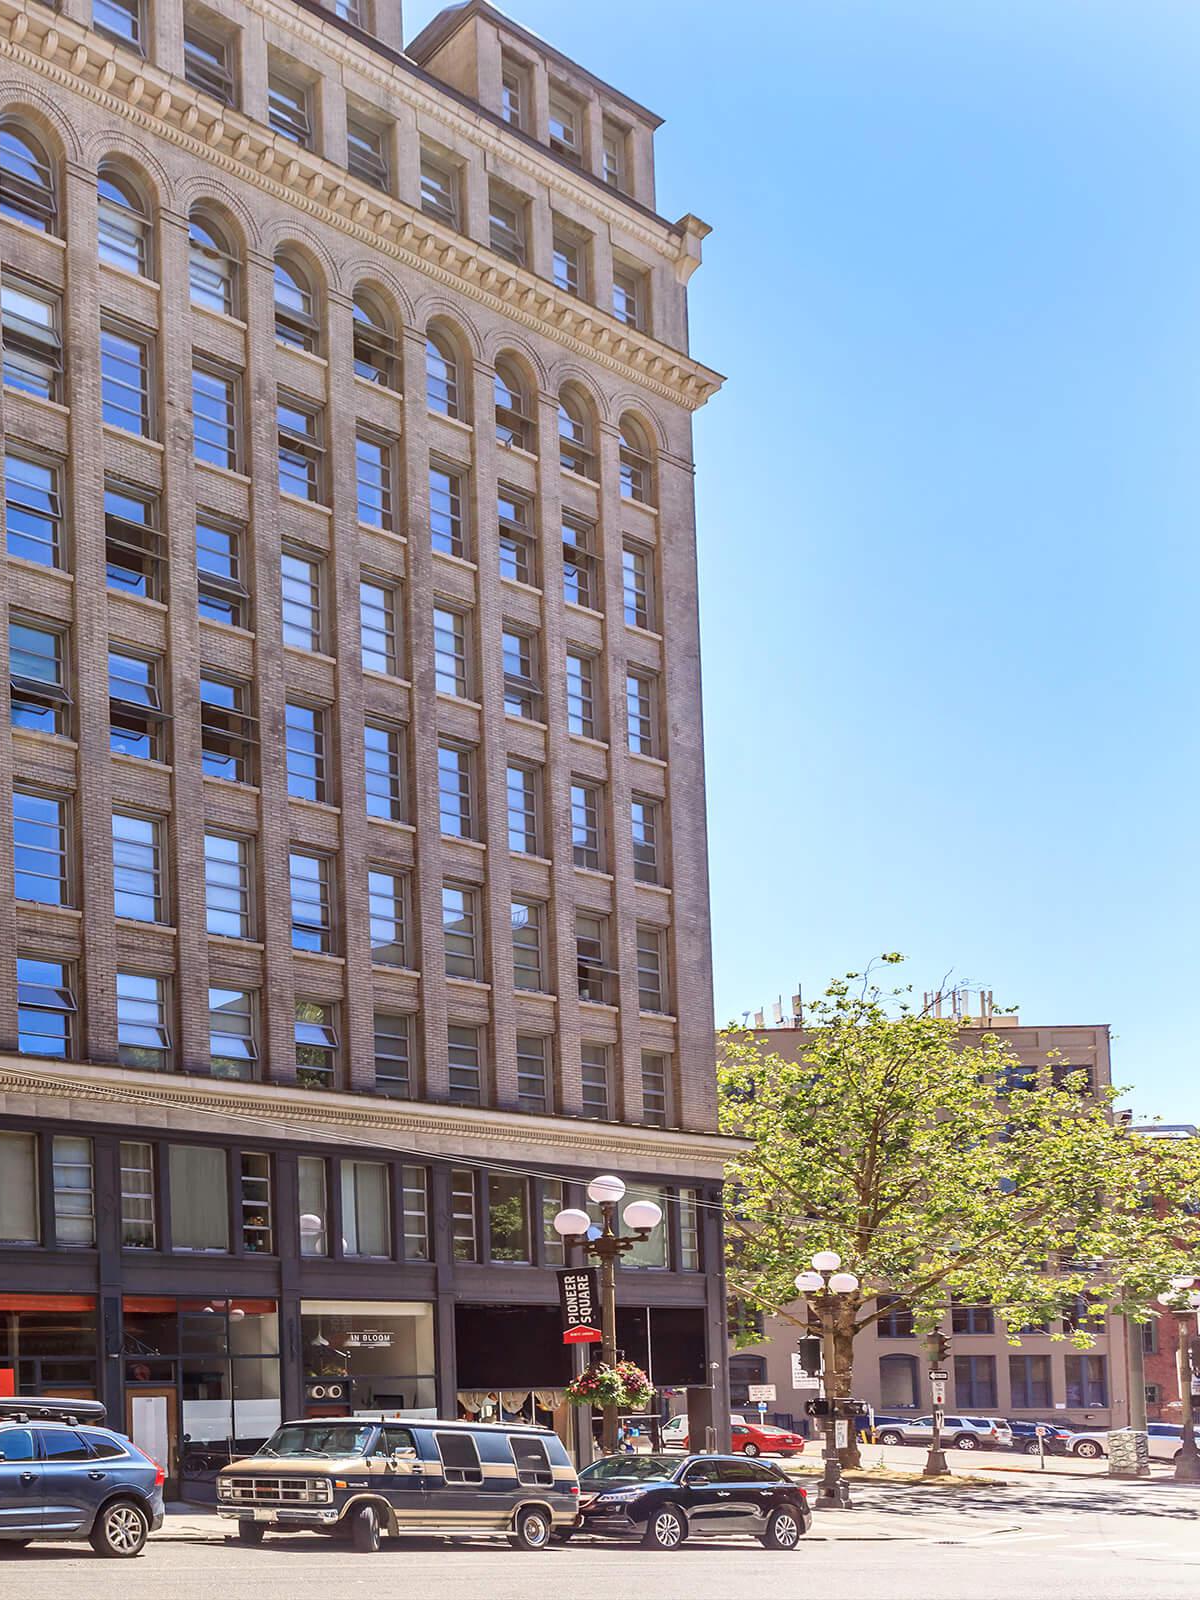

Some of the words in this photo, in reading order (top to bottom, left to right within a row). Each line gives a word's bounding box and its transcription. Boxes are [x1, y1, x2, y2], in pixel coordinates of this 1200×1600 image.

[563, 1275, 580, 1324] PIONEER
[576, 1274, 593, 1324] SQUARE
[351, 1334, 360, 1342] IN
[362, 1334, 390, 1342] BLOOM
